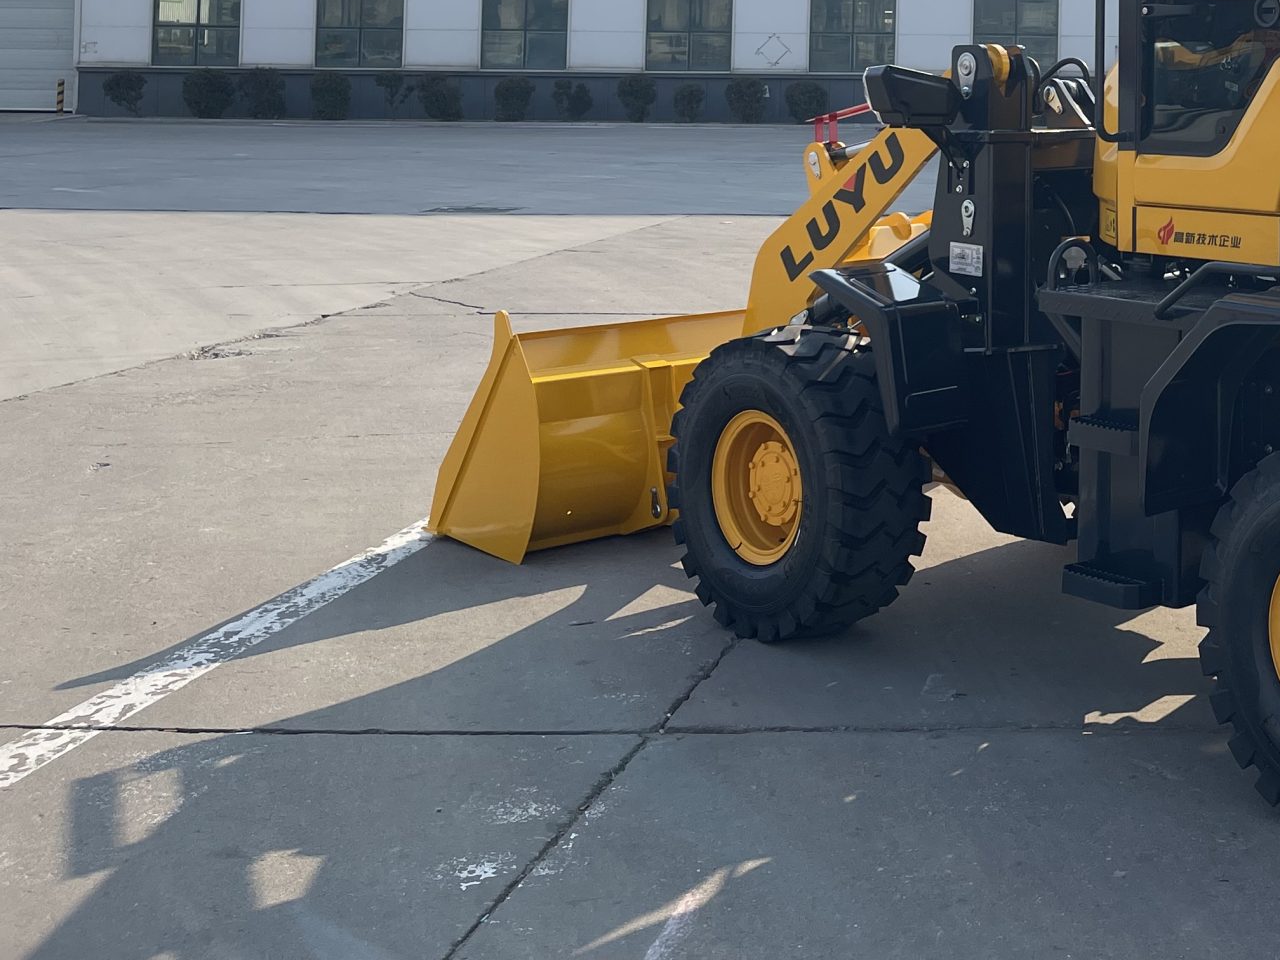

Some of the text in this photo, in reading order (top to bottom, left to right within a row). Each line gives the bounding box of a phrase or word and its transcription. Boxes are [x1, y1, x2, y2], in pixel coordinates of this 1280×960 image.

[780, 131, 905, 282] LUYU
[1173, 231, 1242, 249] 高新技术企业
